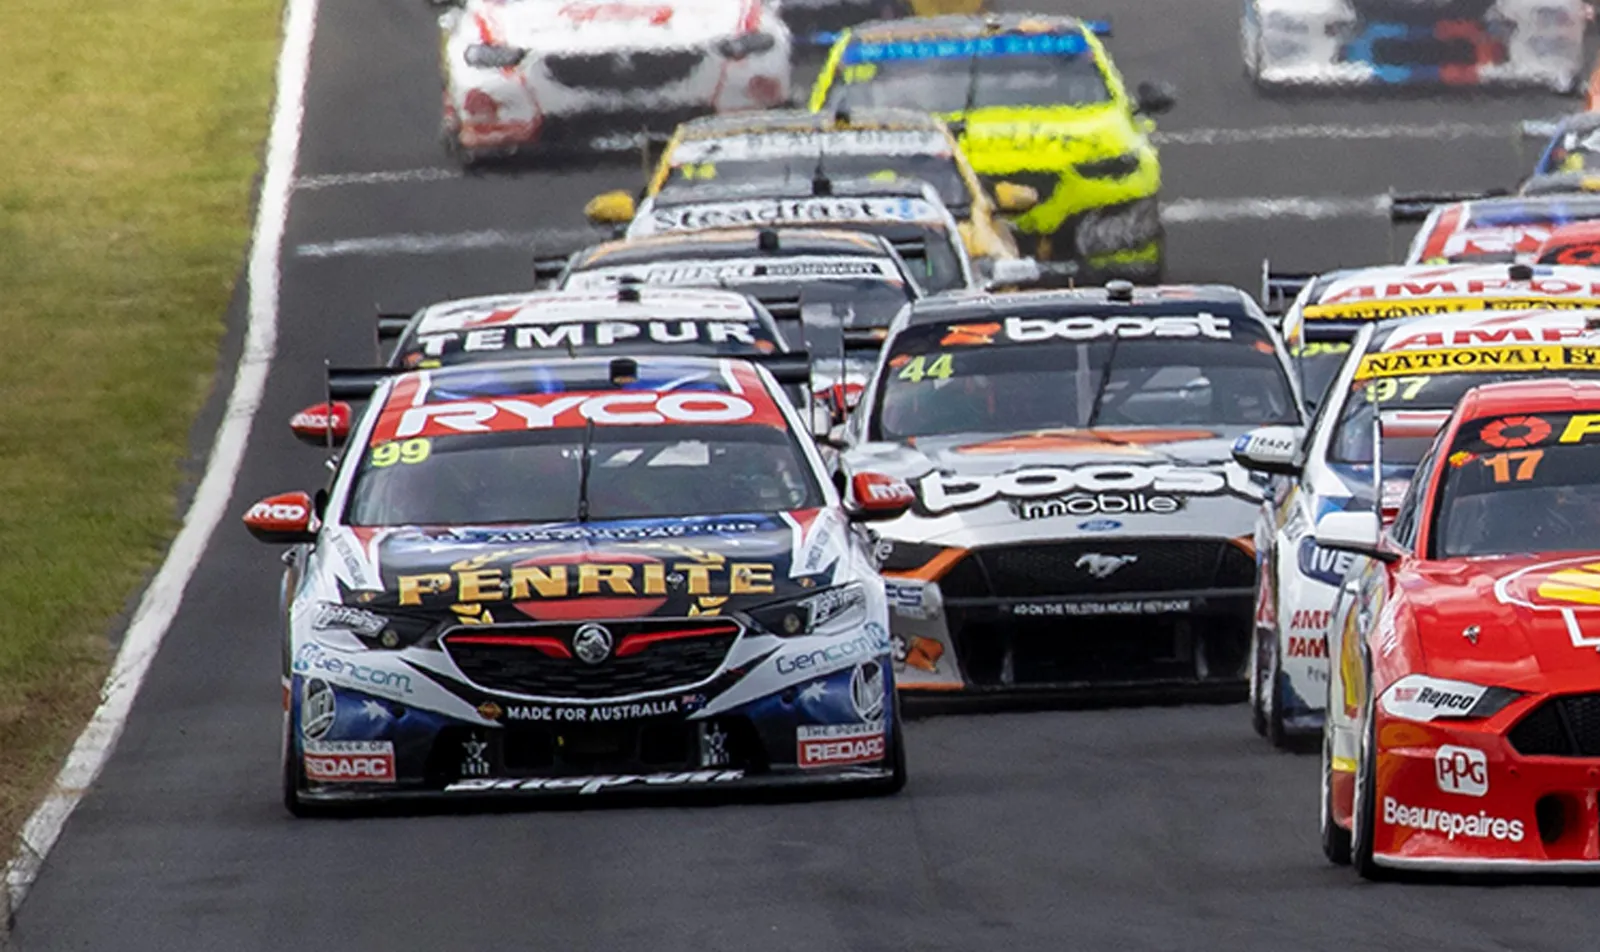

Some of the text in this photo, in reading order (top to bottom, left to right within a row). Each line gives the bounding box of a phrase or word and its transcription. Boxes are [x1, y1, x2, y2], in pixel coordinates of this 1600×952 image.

[417, 321, 756, 358] TEMPUR
[1005, 312, 1233, 342] boost
[898, 353, 955, 383] 44
[1366, 346, 1550, 374] NATIONAL
[1364, 374, 1432, 401] 97
[396, 391, 754, 437] RYCO
[370, 437, 431, 467] 99
[1484, 449, 1545, 482] 17
[248, 501, 307, 521] RYCO
[1023, 494, 1180, 521] mobile
[399, 562, 775, 606] PENRITE
[775, 635, 869, 676] Gencom
[315, 652, 414, 694] Gencom
[507, 700, 679, 721] MADE FOR AUSTRALIA
[1416, 686, 1476, 711] Repco
[1437, 750, 1486, 789] PPG
[1383, 796, 1525, 843] Beaurepaires
